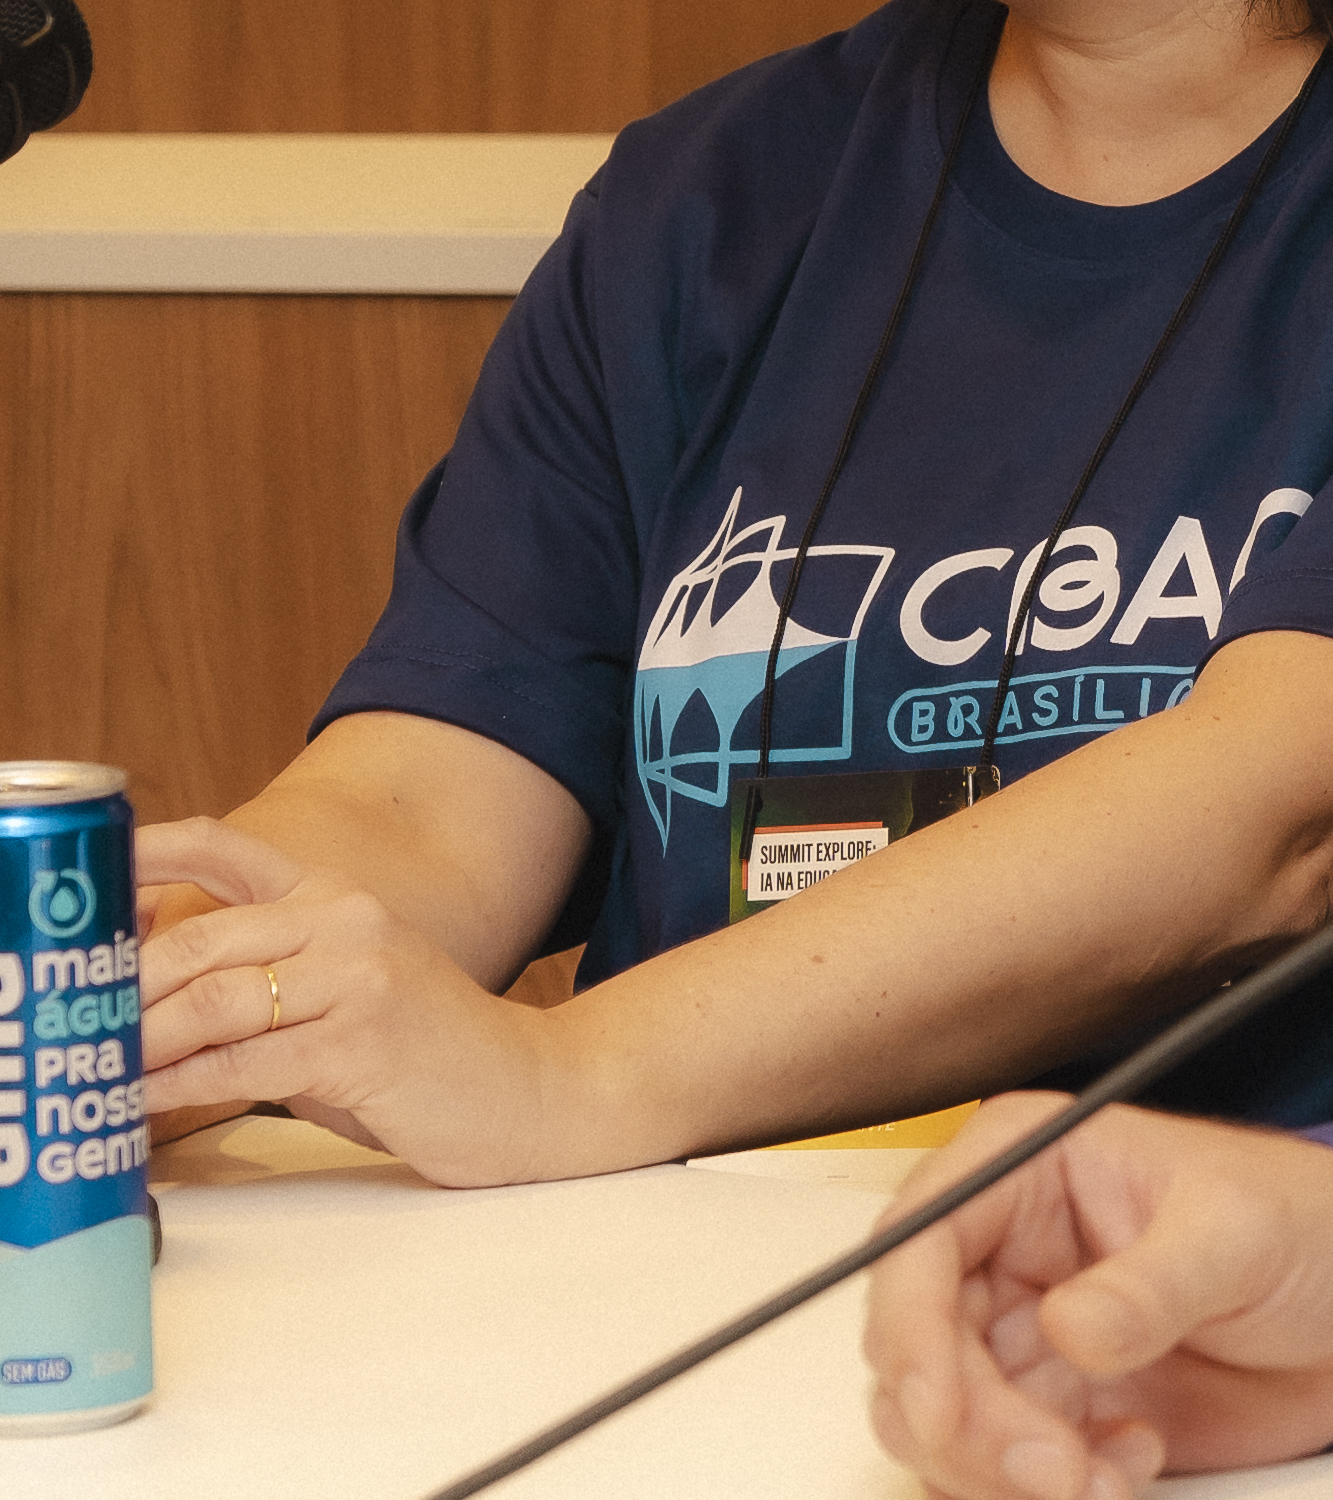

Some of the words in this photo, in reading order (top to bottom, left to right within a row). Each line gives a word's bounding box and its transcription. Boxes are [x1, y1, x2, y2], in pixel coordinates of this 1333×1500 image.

[760, 843, 813, 865] SUMMIT
[760, 872, 773, 892] IA
[776, 871, 794, 891] NA
[32, 930, 140, 992] mais
[36, 1080, 144, 1137] noss
